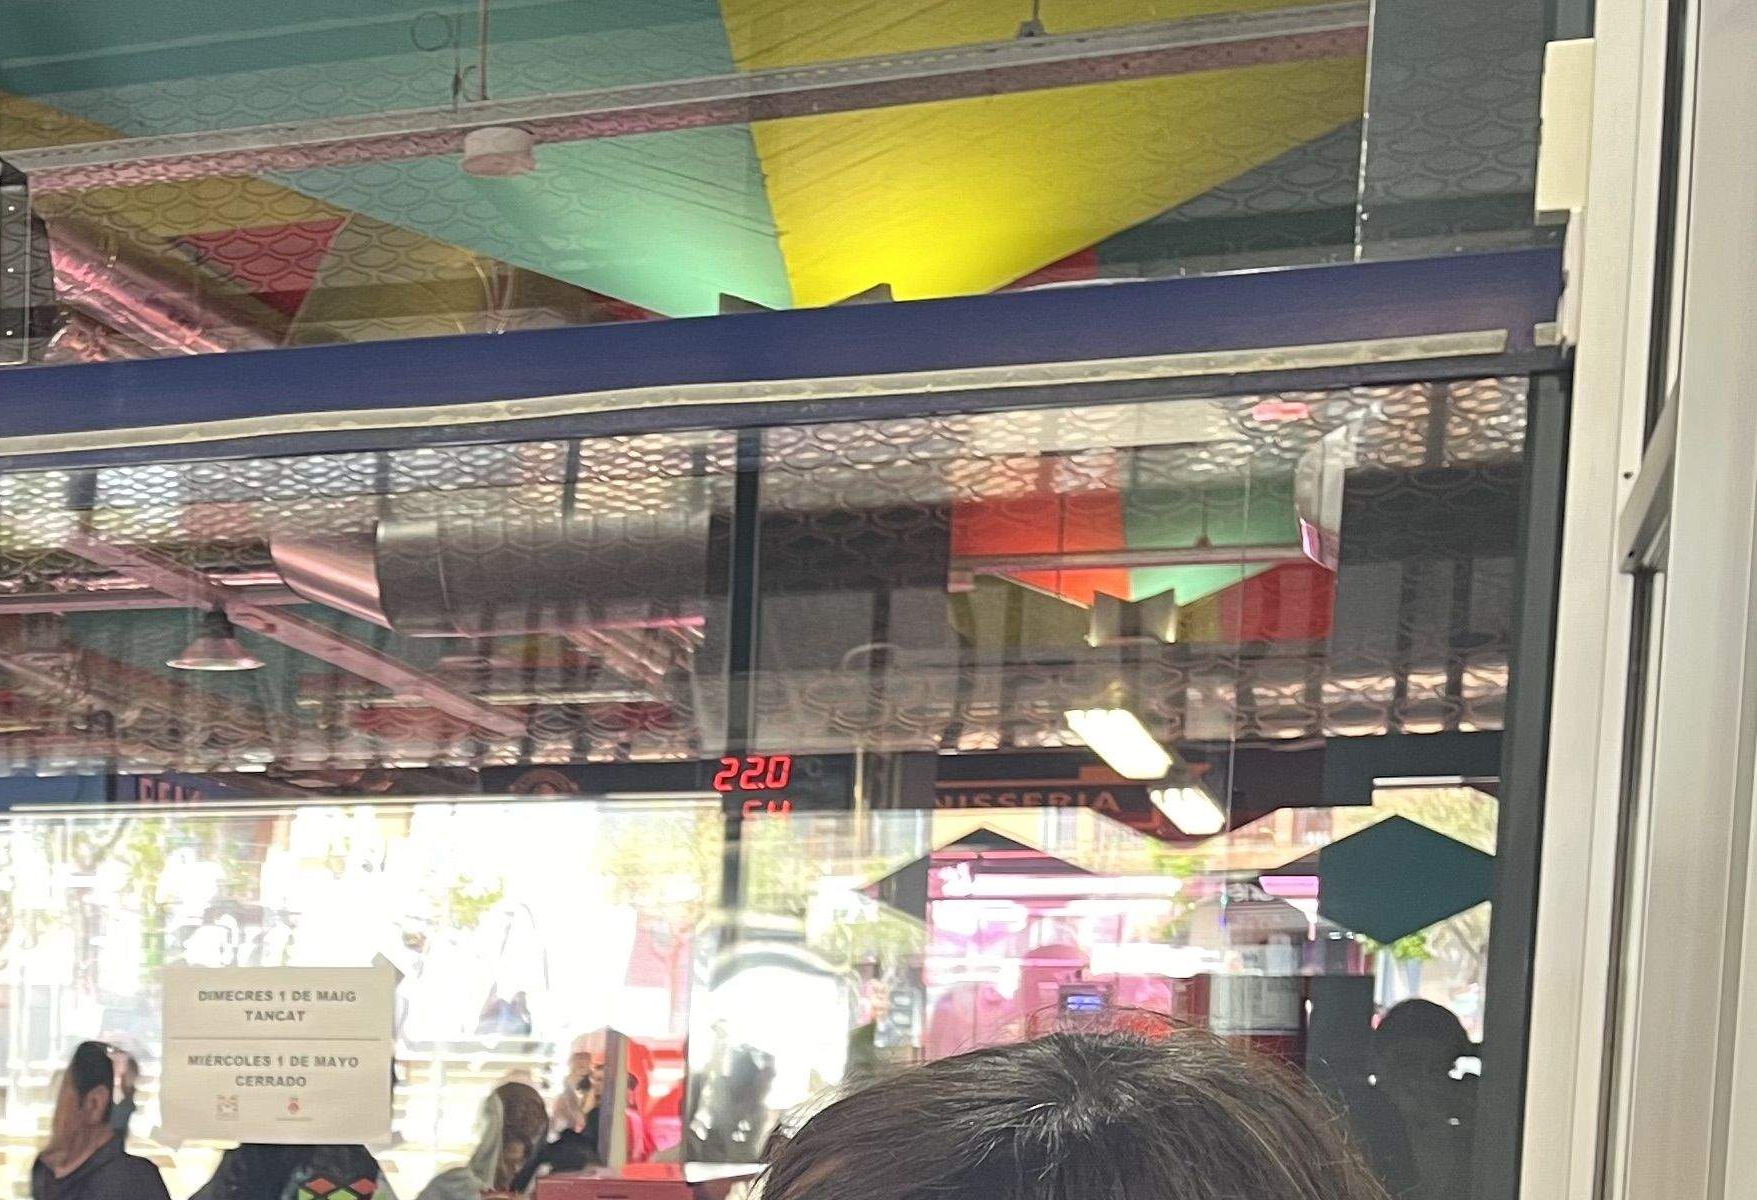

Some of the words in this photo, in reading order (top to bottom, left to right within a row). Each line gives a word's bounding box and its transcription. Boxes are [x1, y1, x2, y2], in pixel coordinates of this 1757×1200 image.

[198, 990, 273, 1002] DIMECRES
[279, 991, 286, 1002] 1
[291, 990, 312, 1002] DE
[316, 990, 357, 1003] MAIG
[245, 1010, 306, 1022] TANCAT
[278, 1056, 284, 1067] 1
[289, 1056, 309, 1068] DE
[314, 1056, 360, 1069] MAYO
[235, 1075, 308, 1088] CERRADO
